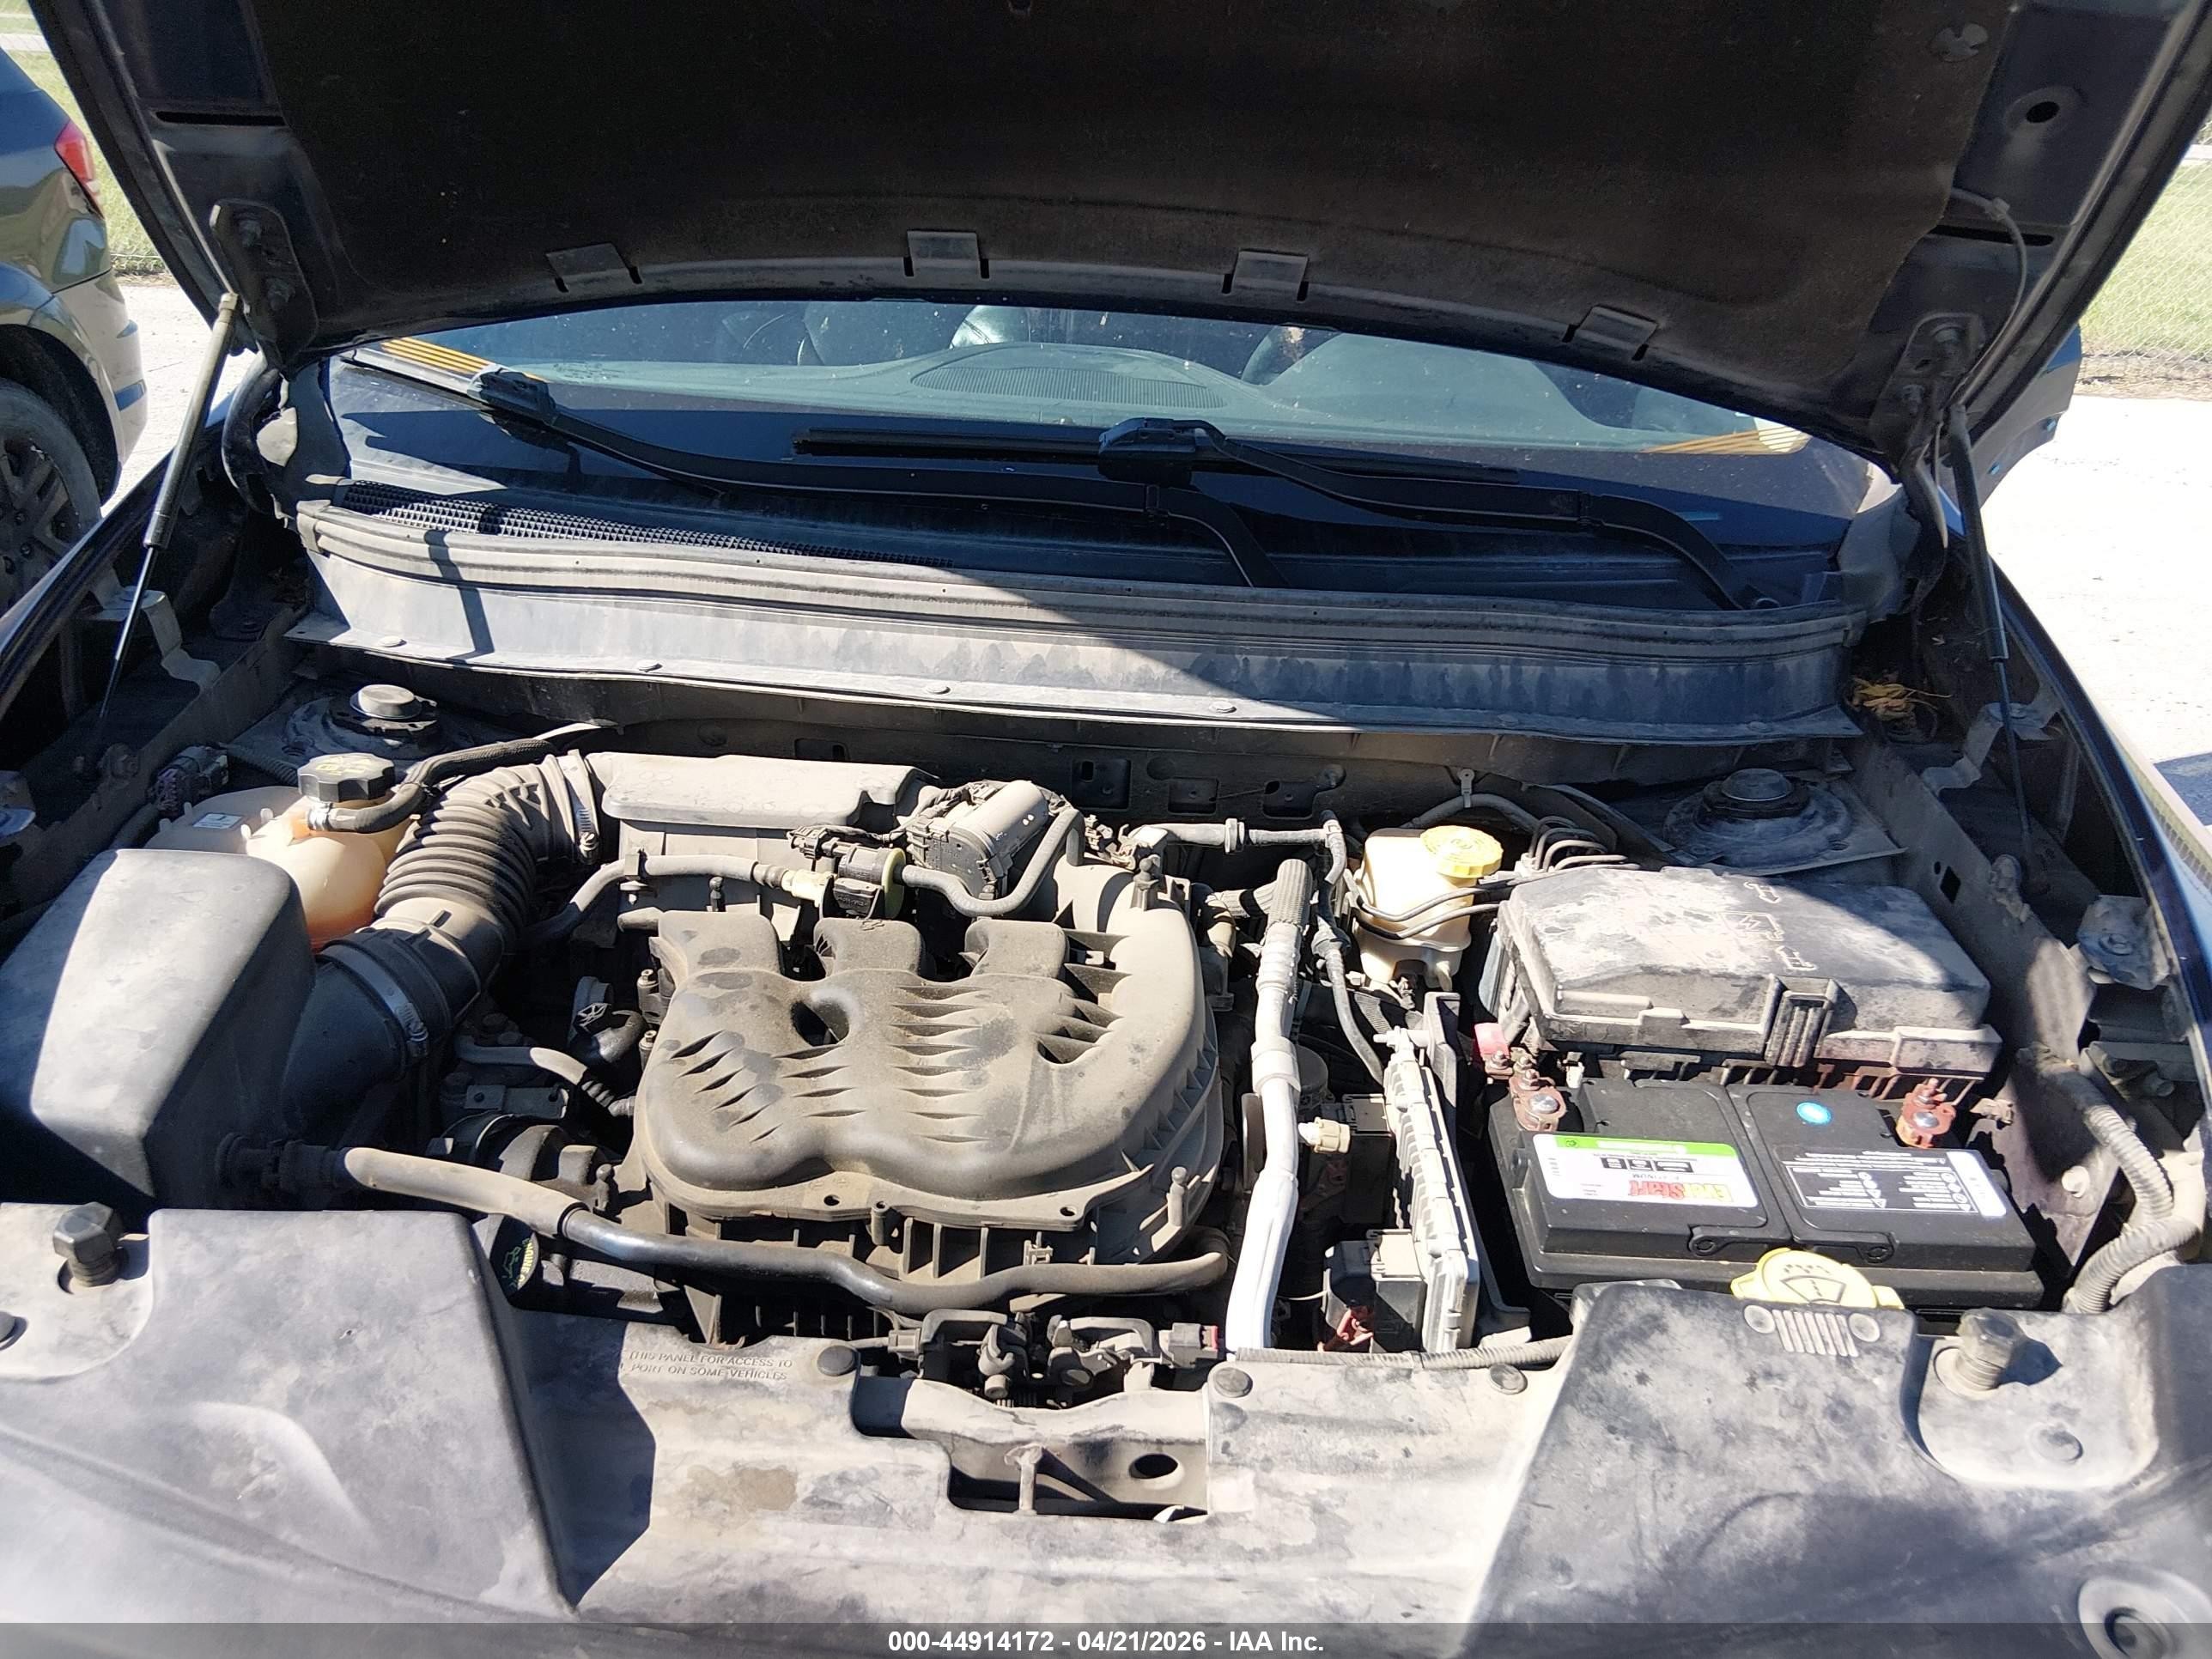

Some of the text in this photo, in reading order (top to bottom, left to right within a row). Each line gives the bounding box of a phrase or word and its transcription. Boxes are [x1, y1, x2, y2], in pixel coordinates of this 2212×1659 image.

[629, 1351, 793, 1368] THIS PANEL FOR ACCESS TO
[668, 1365, 688, 1375] ON
[690, 1366, 725, 1376] SOME
[730, 1369, 787, 1381] VEHICLES
